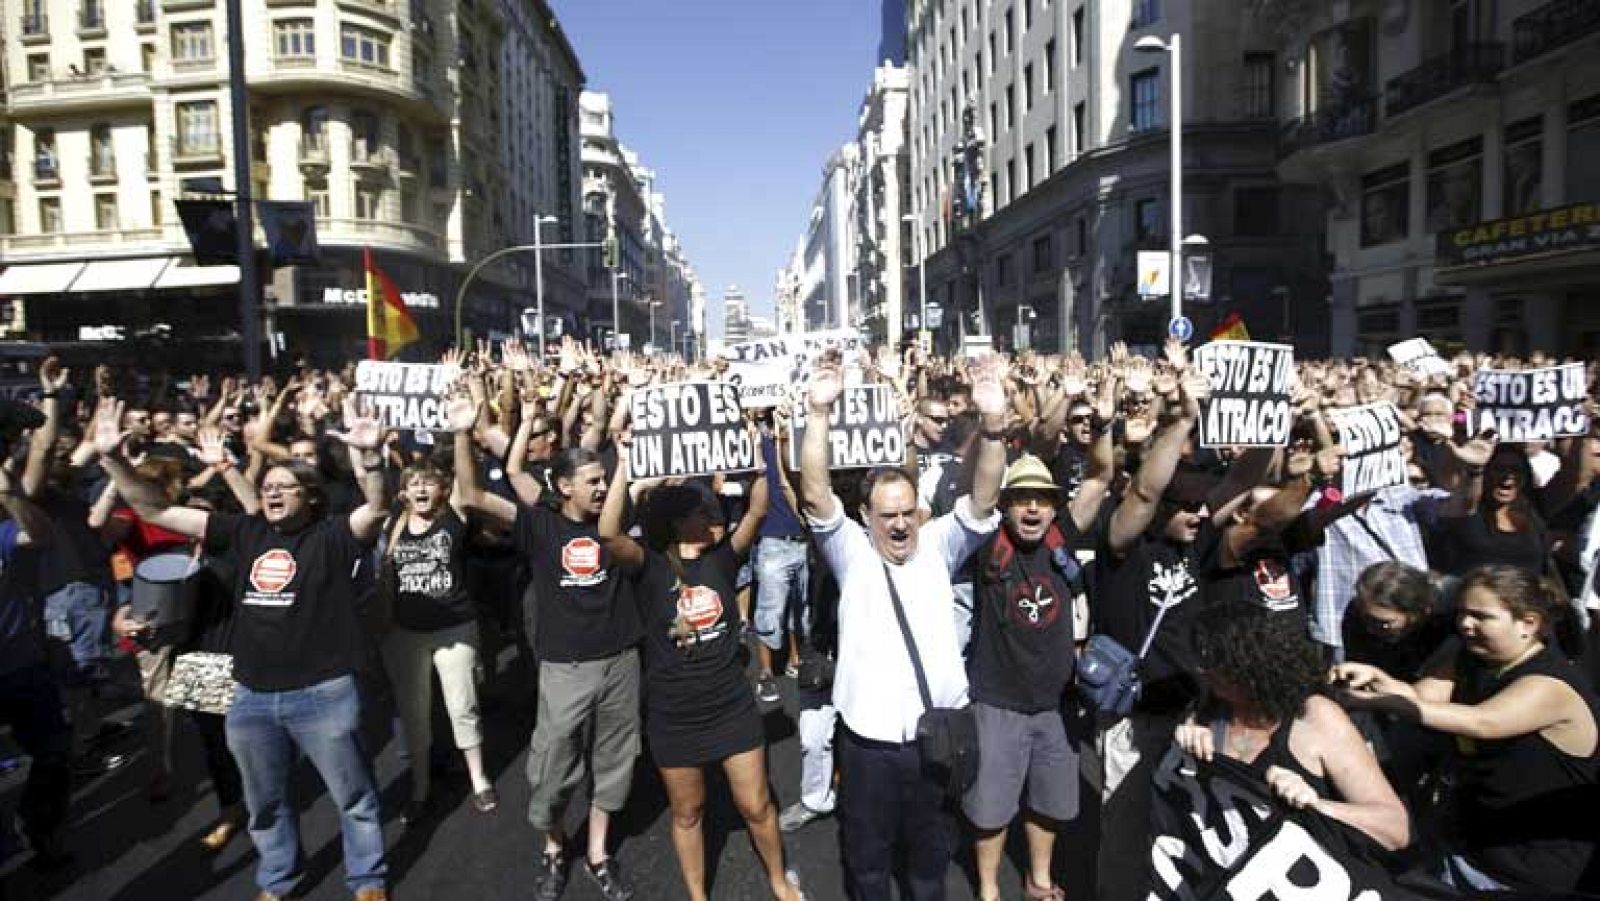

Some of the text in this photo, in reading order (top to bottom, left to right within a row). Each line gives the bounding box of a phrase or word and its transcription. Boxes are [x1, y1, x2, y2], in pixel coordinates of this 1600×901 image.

[1455, 206, 1600, 245] CAFETER
[1248, 348, 1273, 393] ES
[1532, 370, 1558, 404] ES
[632, 383, 741, 430] ESTO ES
[845, 387, 868, 424] ES
[1207, 398, 1288, 443] ATRACO
[632, 428, 751, 477] UN ATRACO
